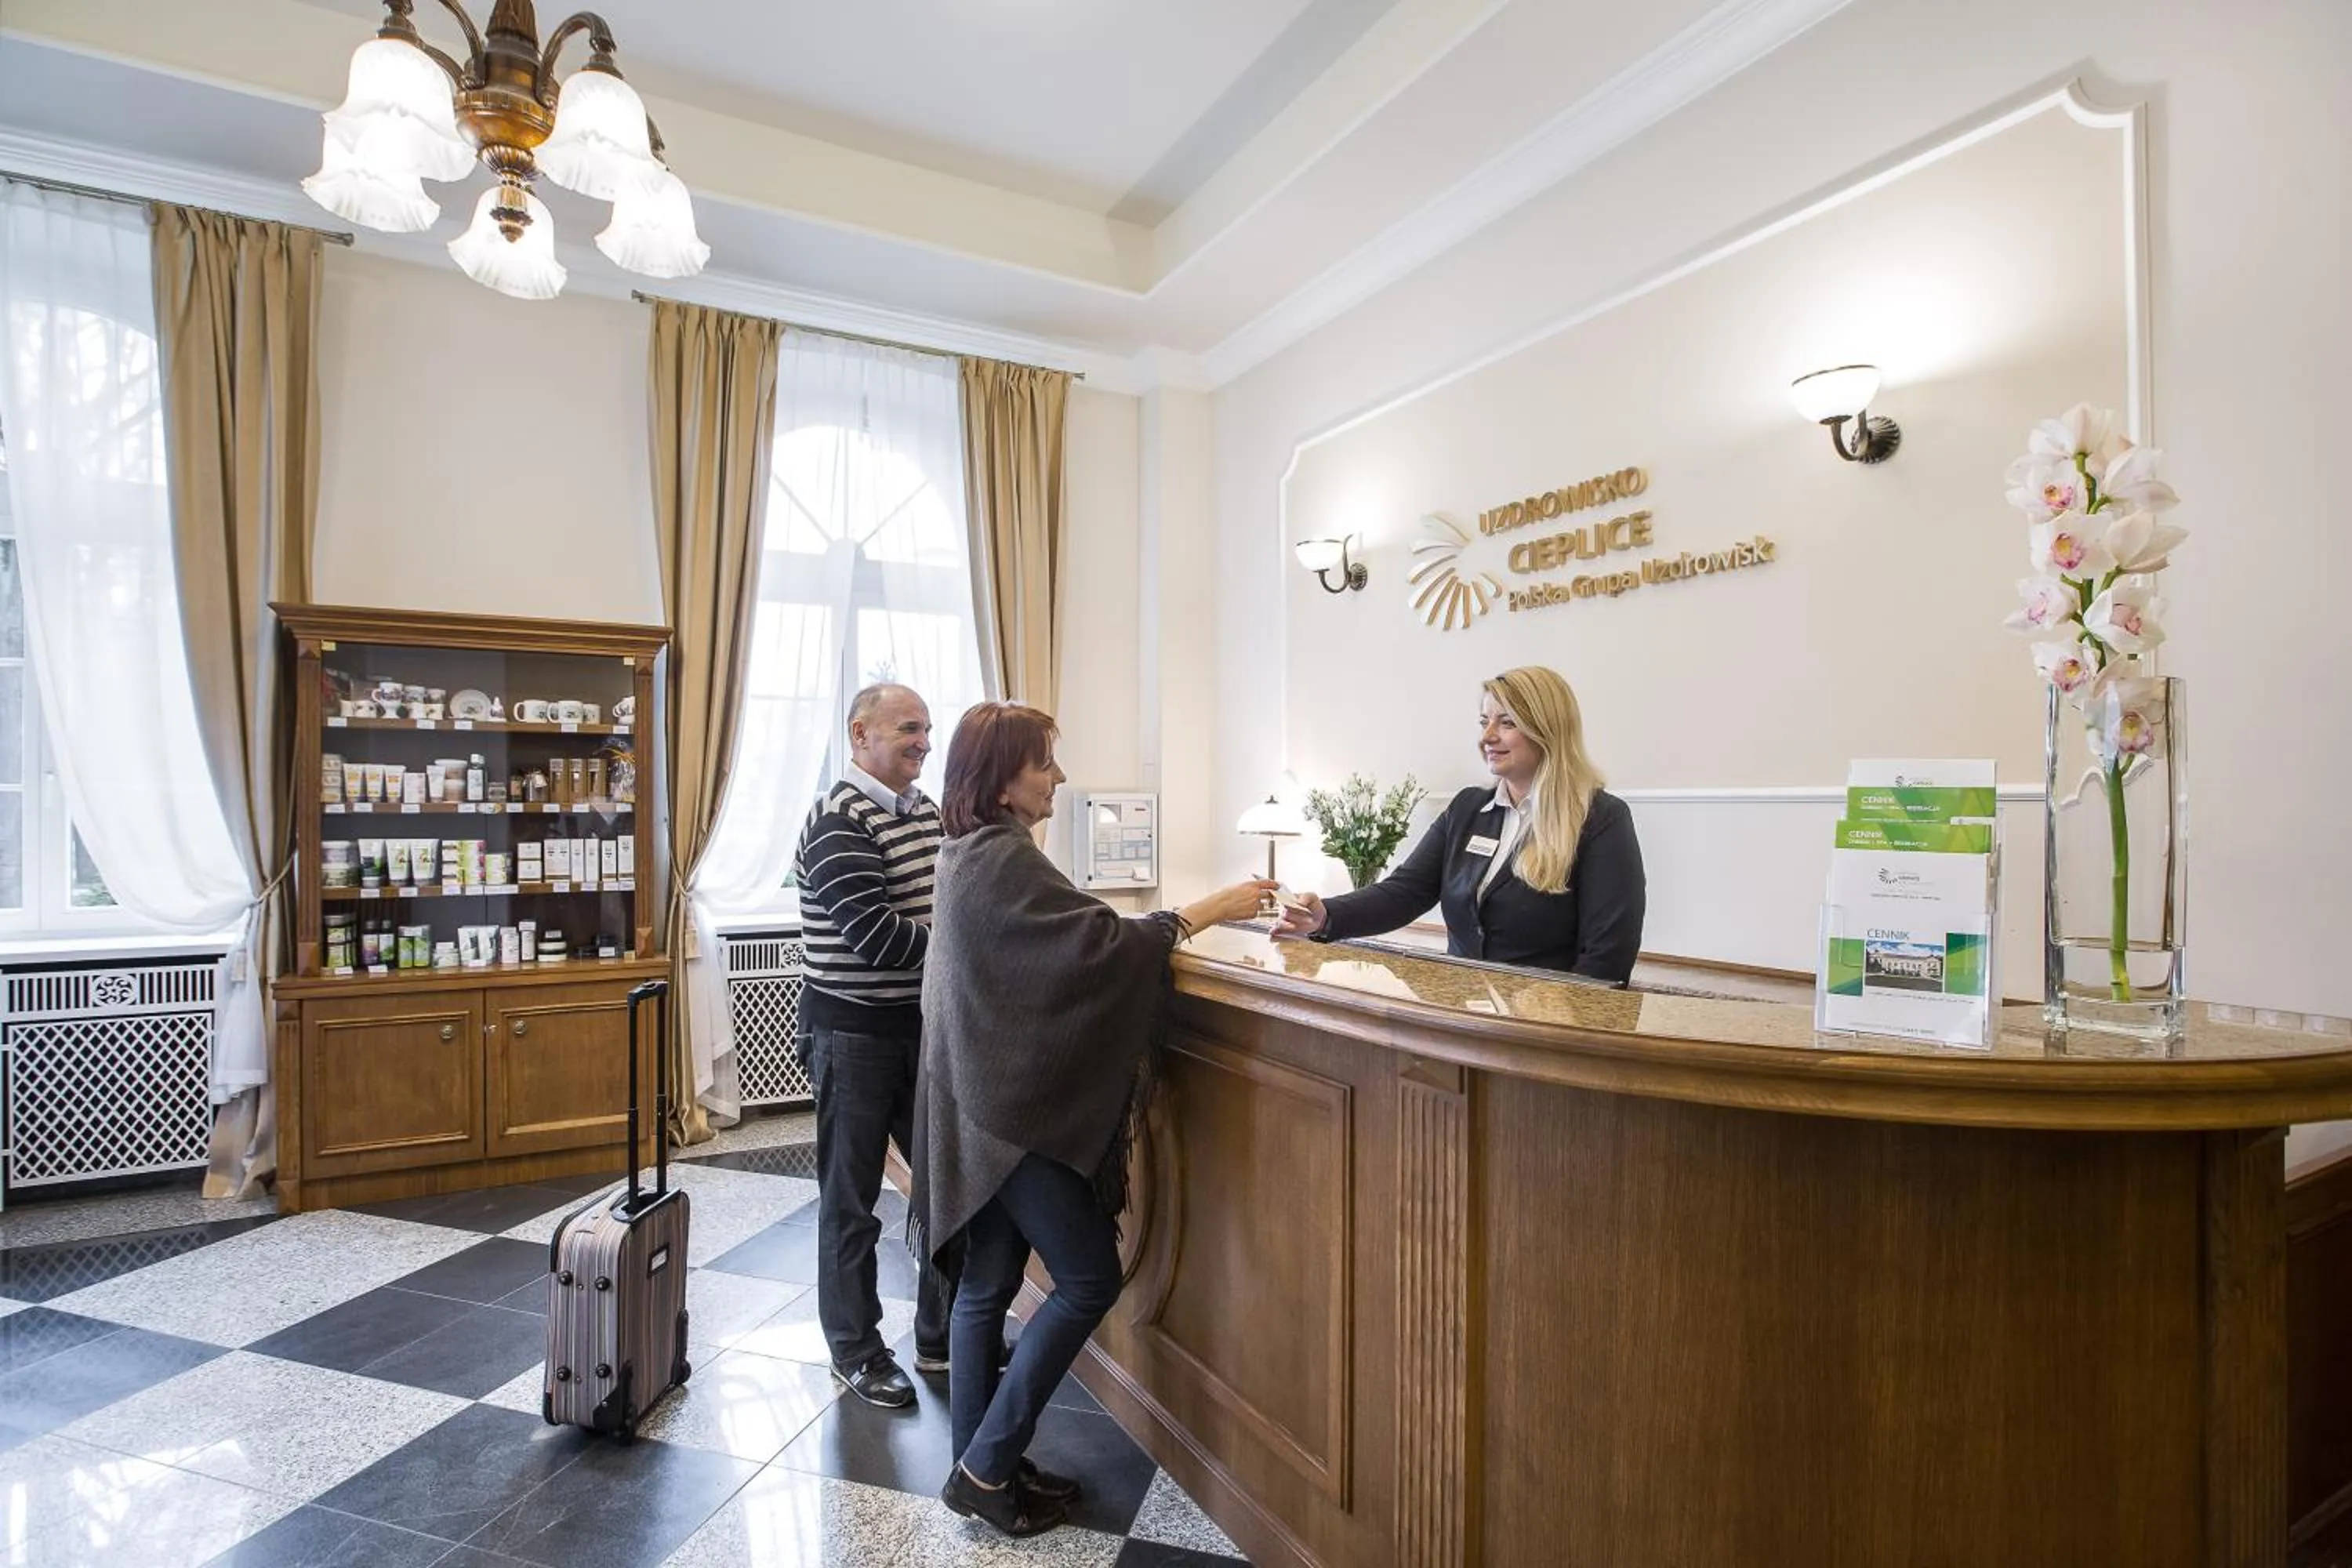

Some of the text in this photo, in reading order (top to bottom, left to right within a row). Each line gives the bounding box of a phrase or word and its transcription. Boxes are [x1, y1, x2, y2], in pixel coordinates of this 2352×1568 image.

[1479, 466, 1649, 536] UZDROWISKO
[1508, 510, 1653, 575] CIEPLICE
[1508, 535, 1776, 612] Polska Grupa Uzdrowisk
[1867, 927, 1911, 940] CENNIK
